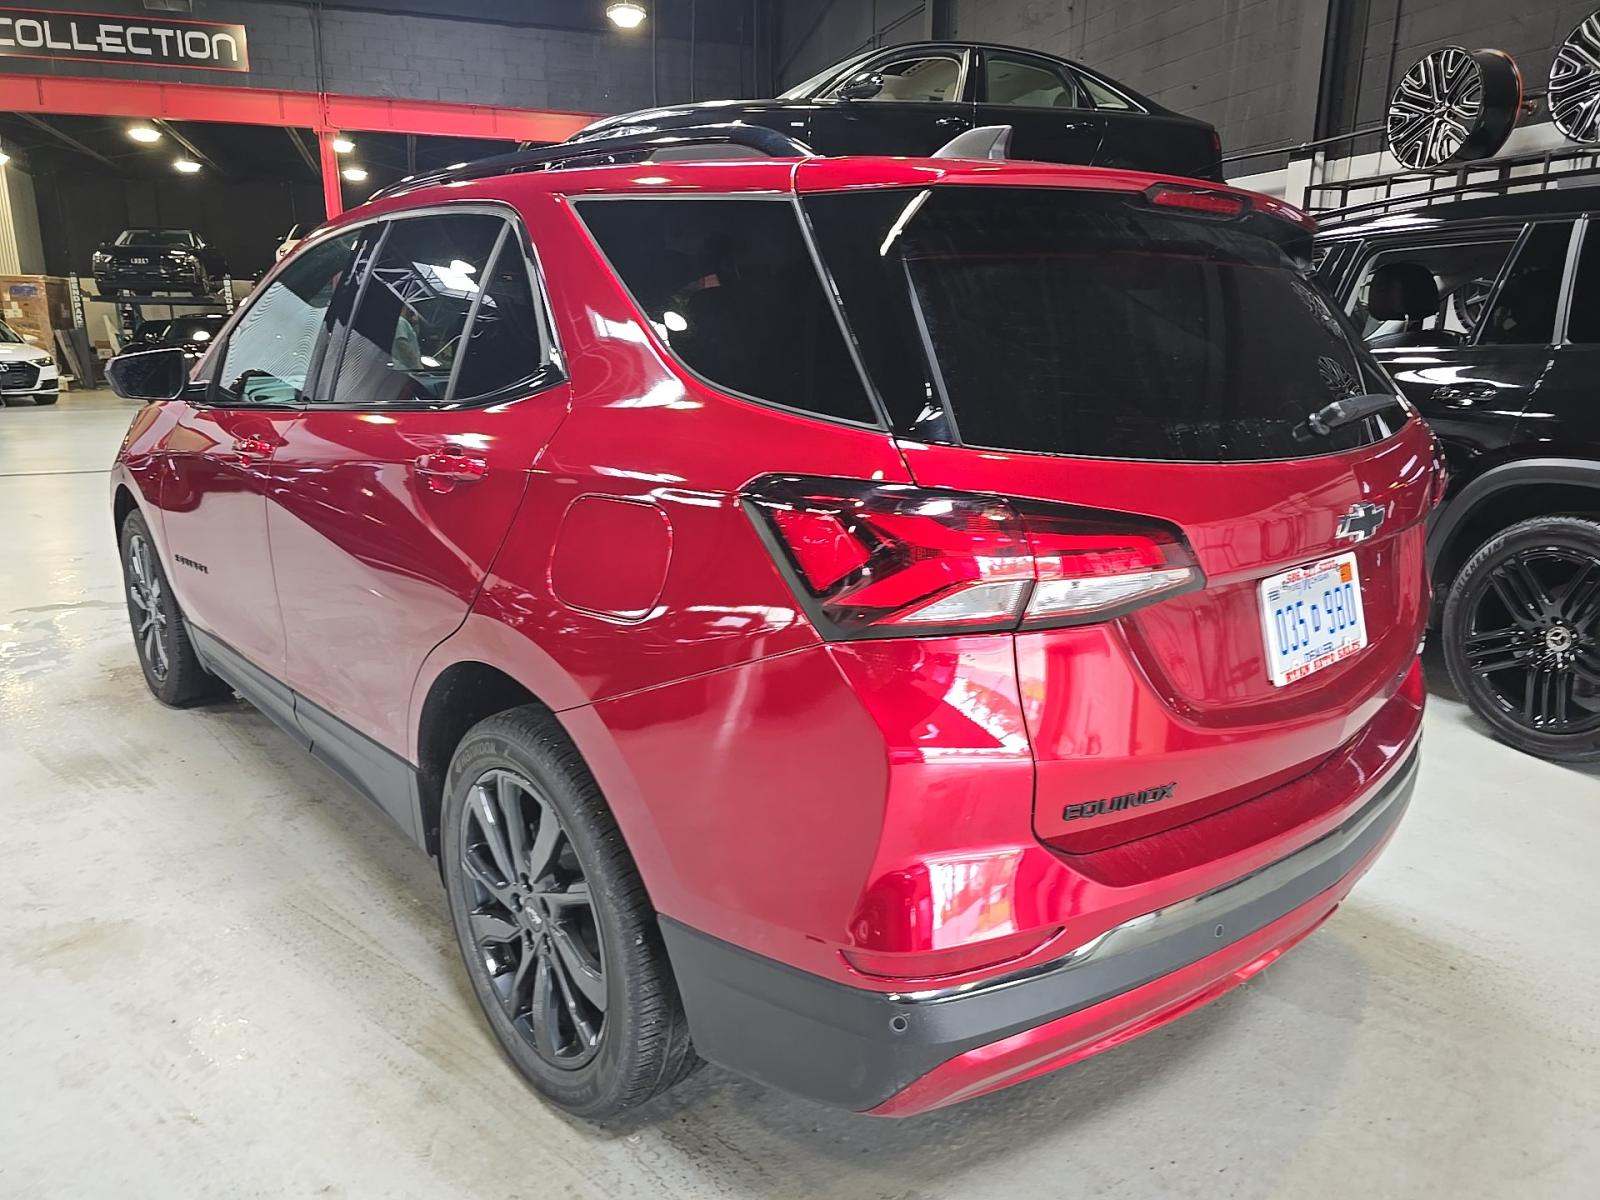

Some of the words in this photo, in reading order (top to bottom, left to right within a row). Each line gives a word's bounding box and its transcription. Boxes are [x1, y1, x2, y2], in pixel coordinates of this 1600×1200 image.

[1275, 600, 1310, 656] 035
[1323, 583, 1357, 634] 980
[1063, 781, 1177, 821] EQUINOX
